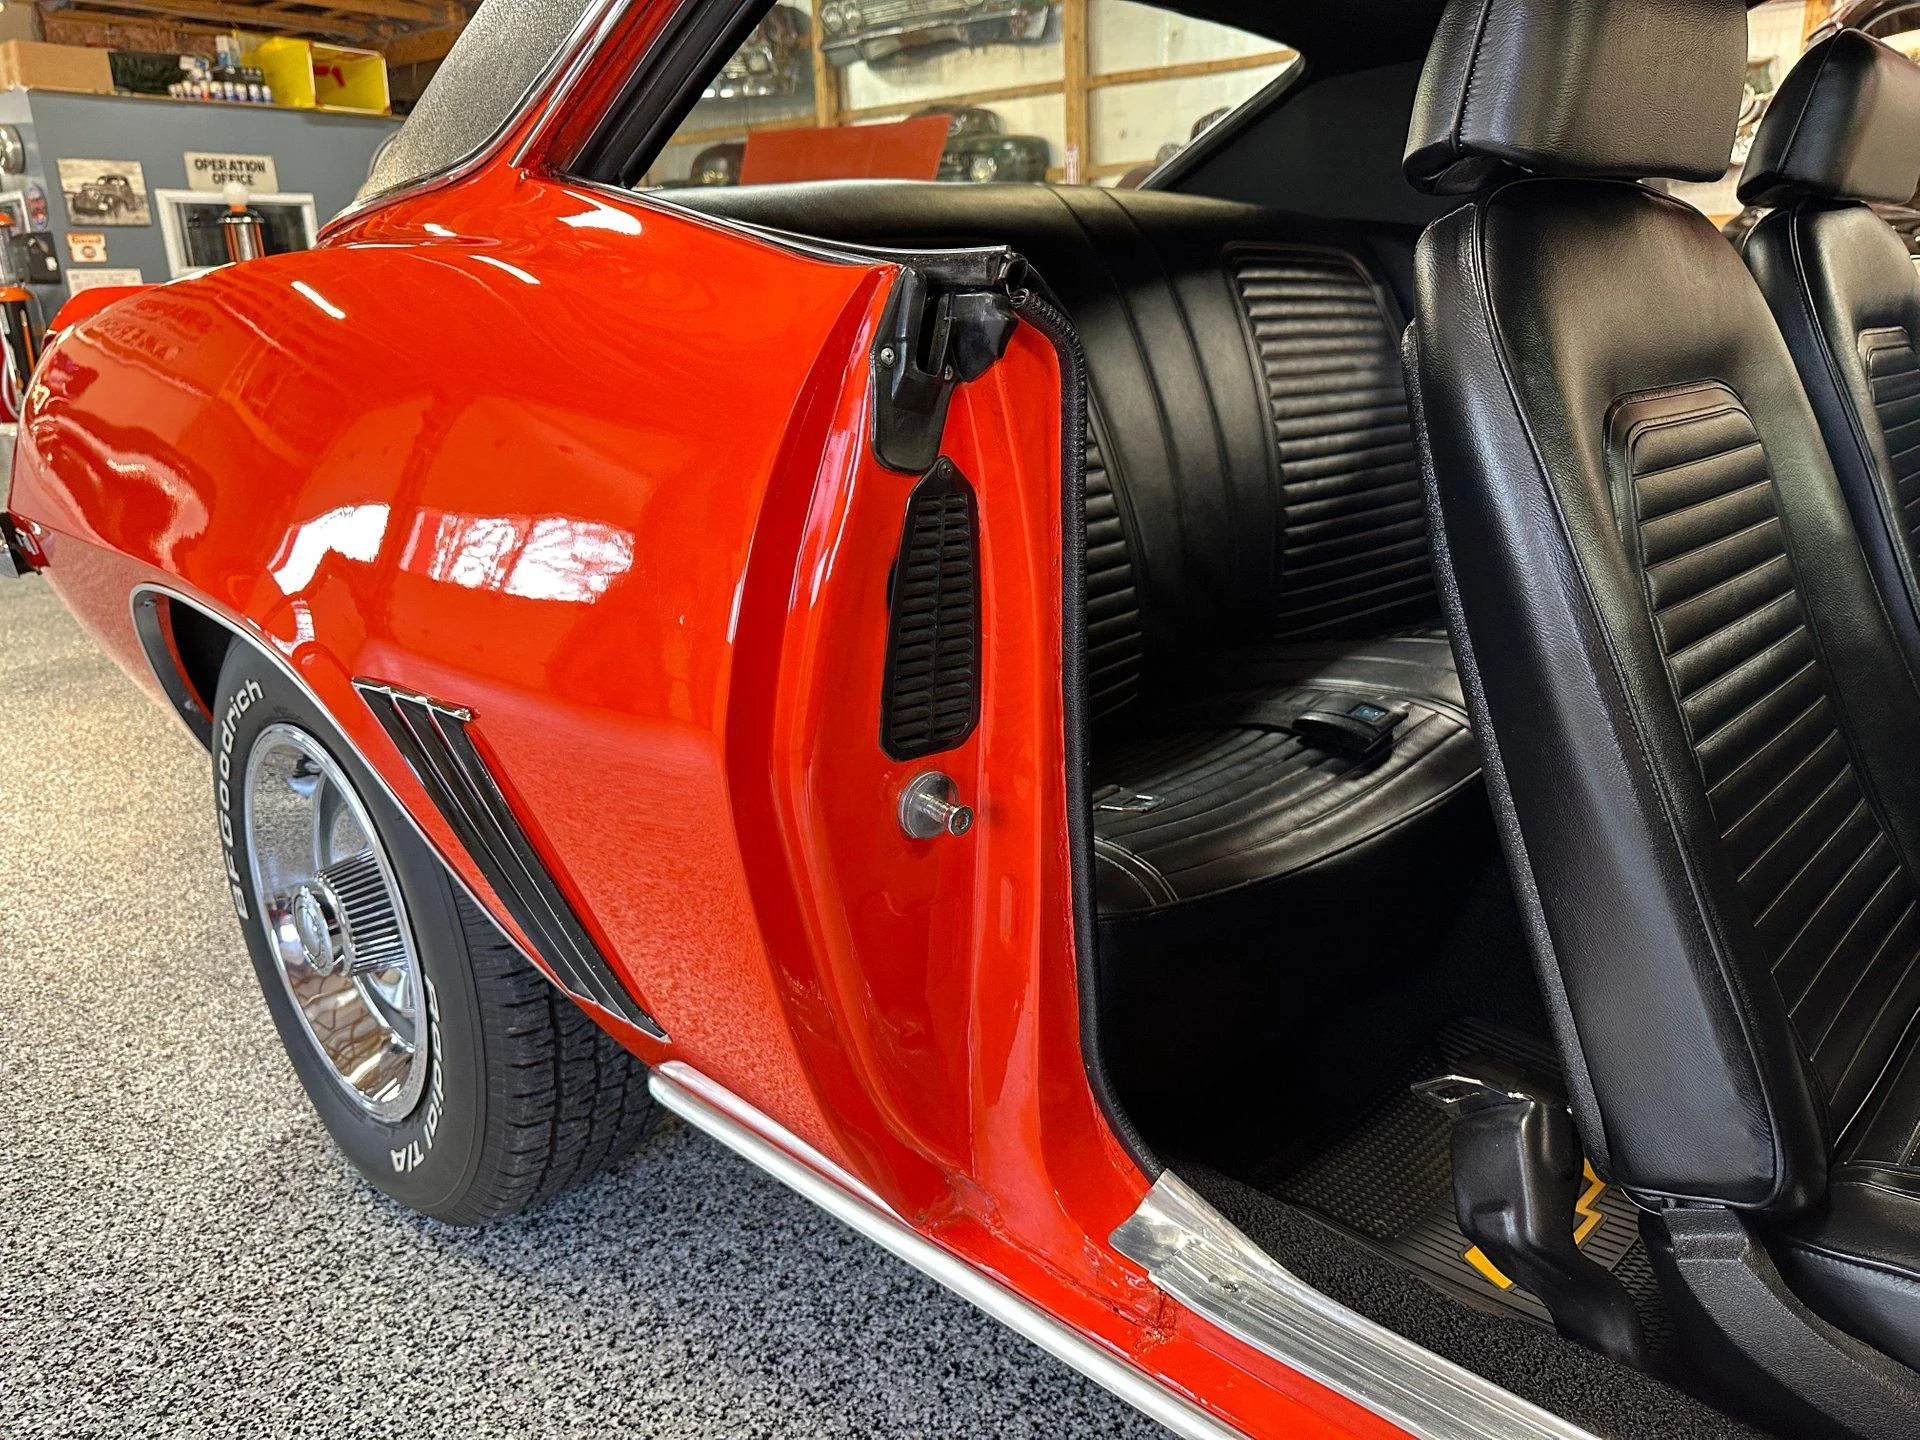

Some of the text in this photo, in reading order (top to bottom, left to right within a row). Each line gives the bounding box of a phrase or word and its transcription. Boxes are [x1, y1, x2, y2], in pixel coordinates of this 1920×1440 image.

[194, 159, 265, 172] OPERATION
[212, 173, 254, 186] OFFICE
[219, 679, 264, 920] BFGoodrich
[390, 974, 444, 1172] Radial T/A
